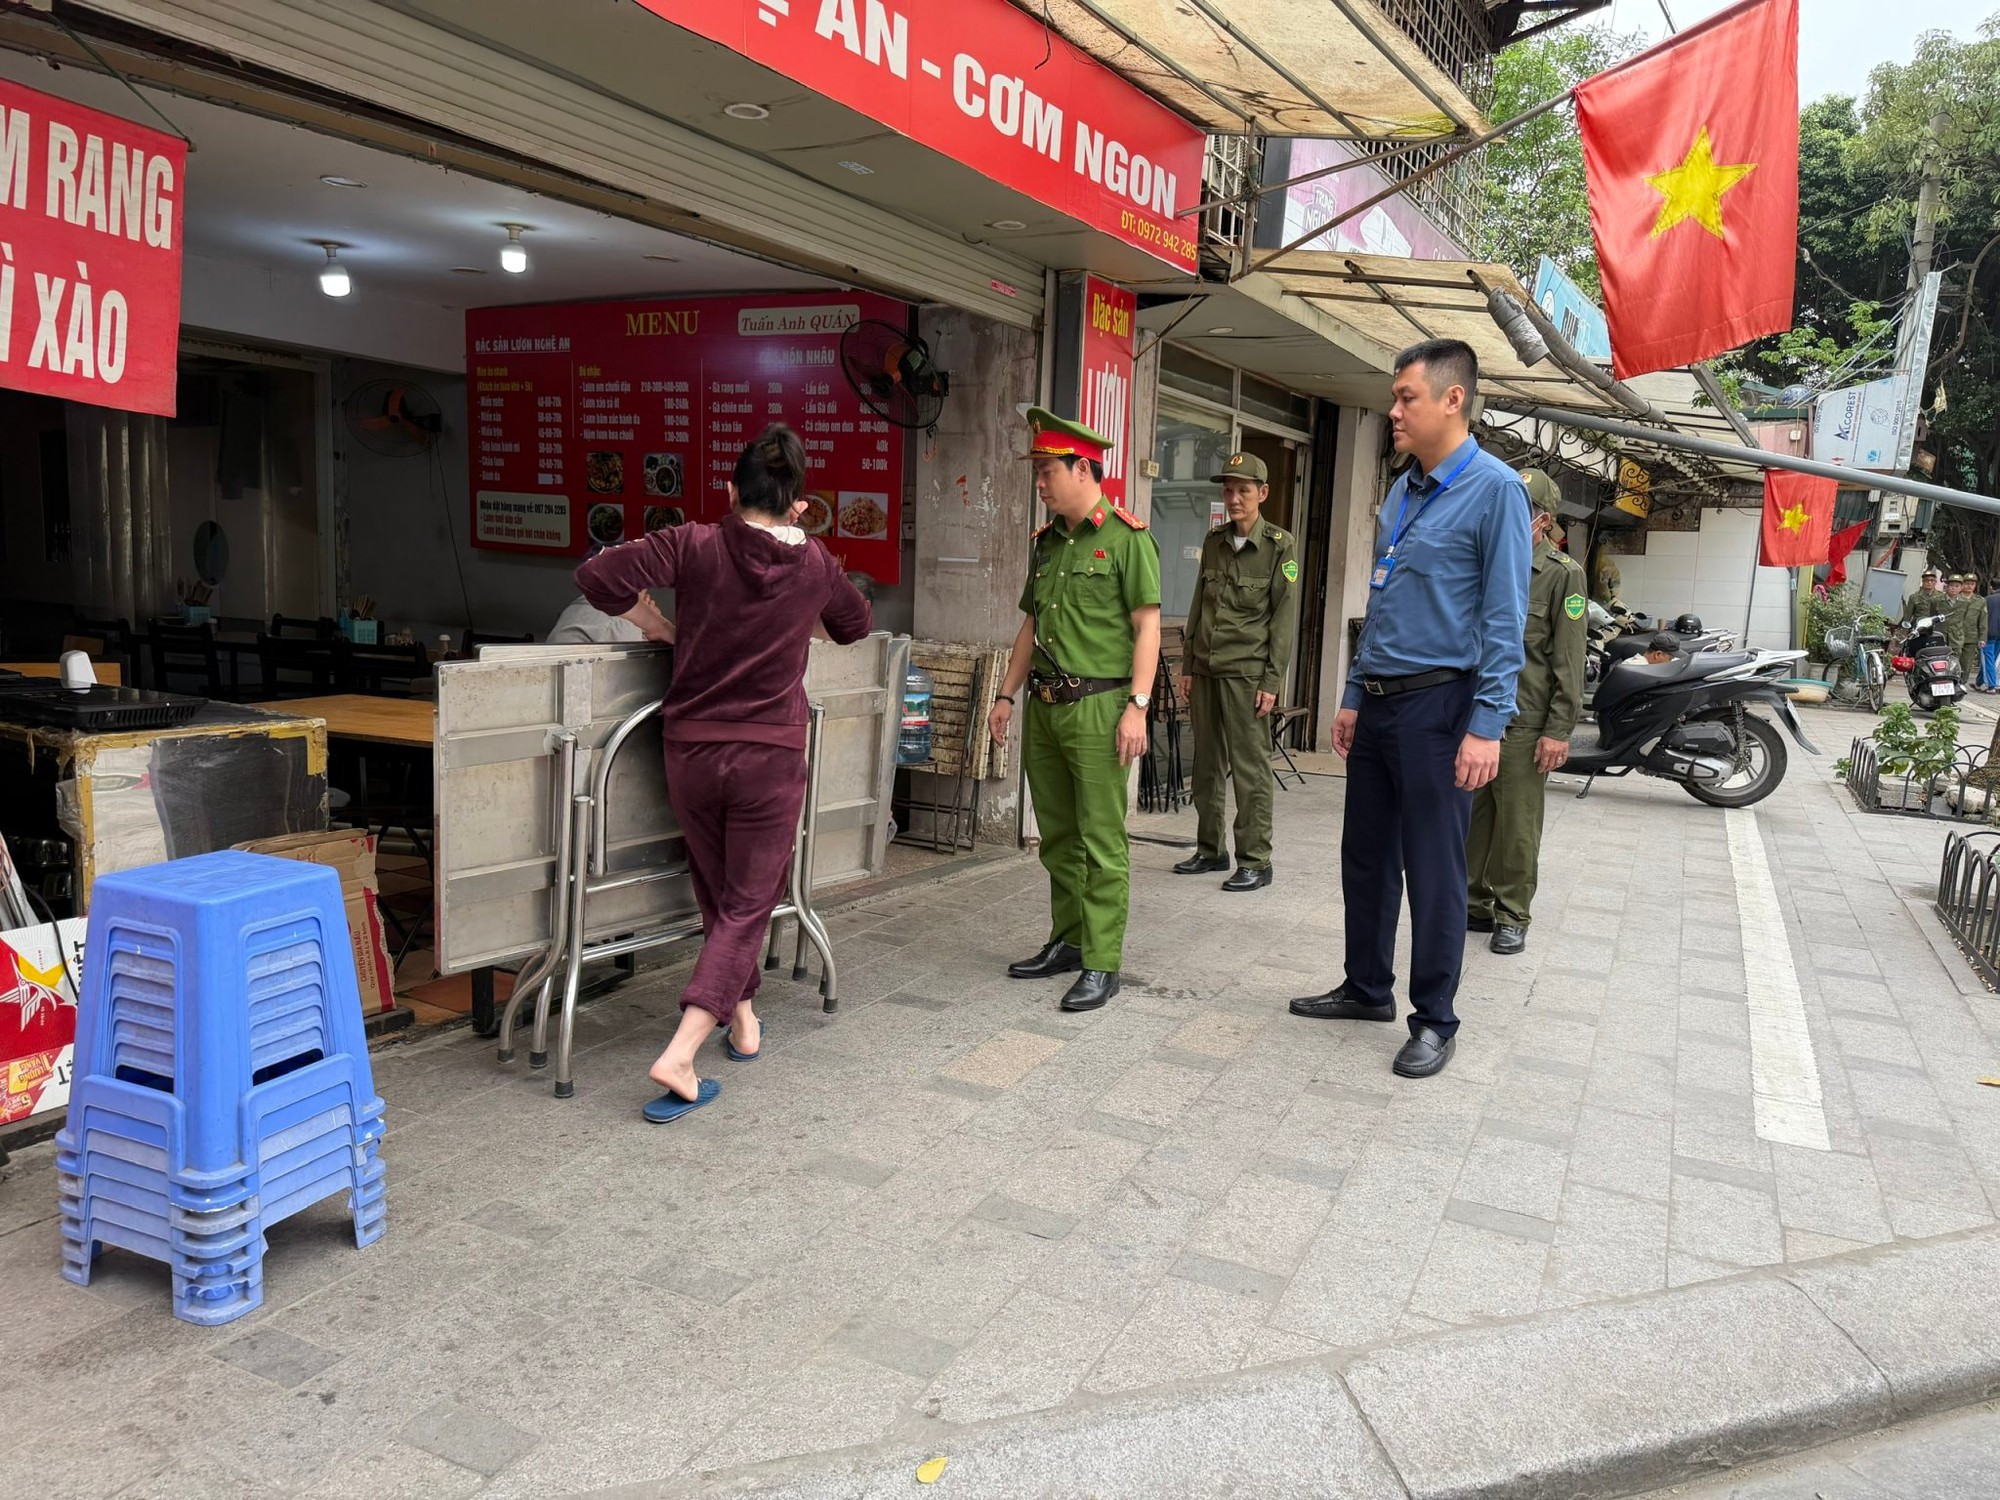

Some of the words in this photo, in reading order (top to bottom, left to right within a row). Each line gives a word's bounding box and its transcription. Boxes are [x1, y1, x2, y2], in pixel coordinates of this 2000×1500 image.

[815, 0, 908, 80] AN
[952, 52, 1064, 164] CƠM
[1074, 119, 1177, 221] NGON
[46, 120, 175, 251] RANG
[1121, 209, 1137, 232] ĐT:
[1138, 216, 1160, 245] 0972
[1162, 230, 1179, 252] 942
[1180, 240, 1198, 262] 285
[27, 259, 128, 384] XÀO
[625, 309, 701, 337] MENU
[742, 315, 775, 331] Tuấn
[777, 316, 806, 331] Anh
[810, 309, 856, 332] QUÁN
[1093, 293, 1111, 338] Đặc
[1112, 299, 1130, 338] sản
[559, 337, 571, 351] AN
[806, 344, 836, 367] NHẬU
[861, 457, 888, 471] 50-100k
